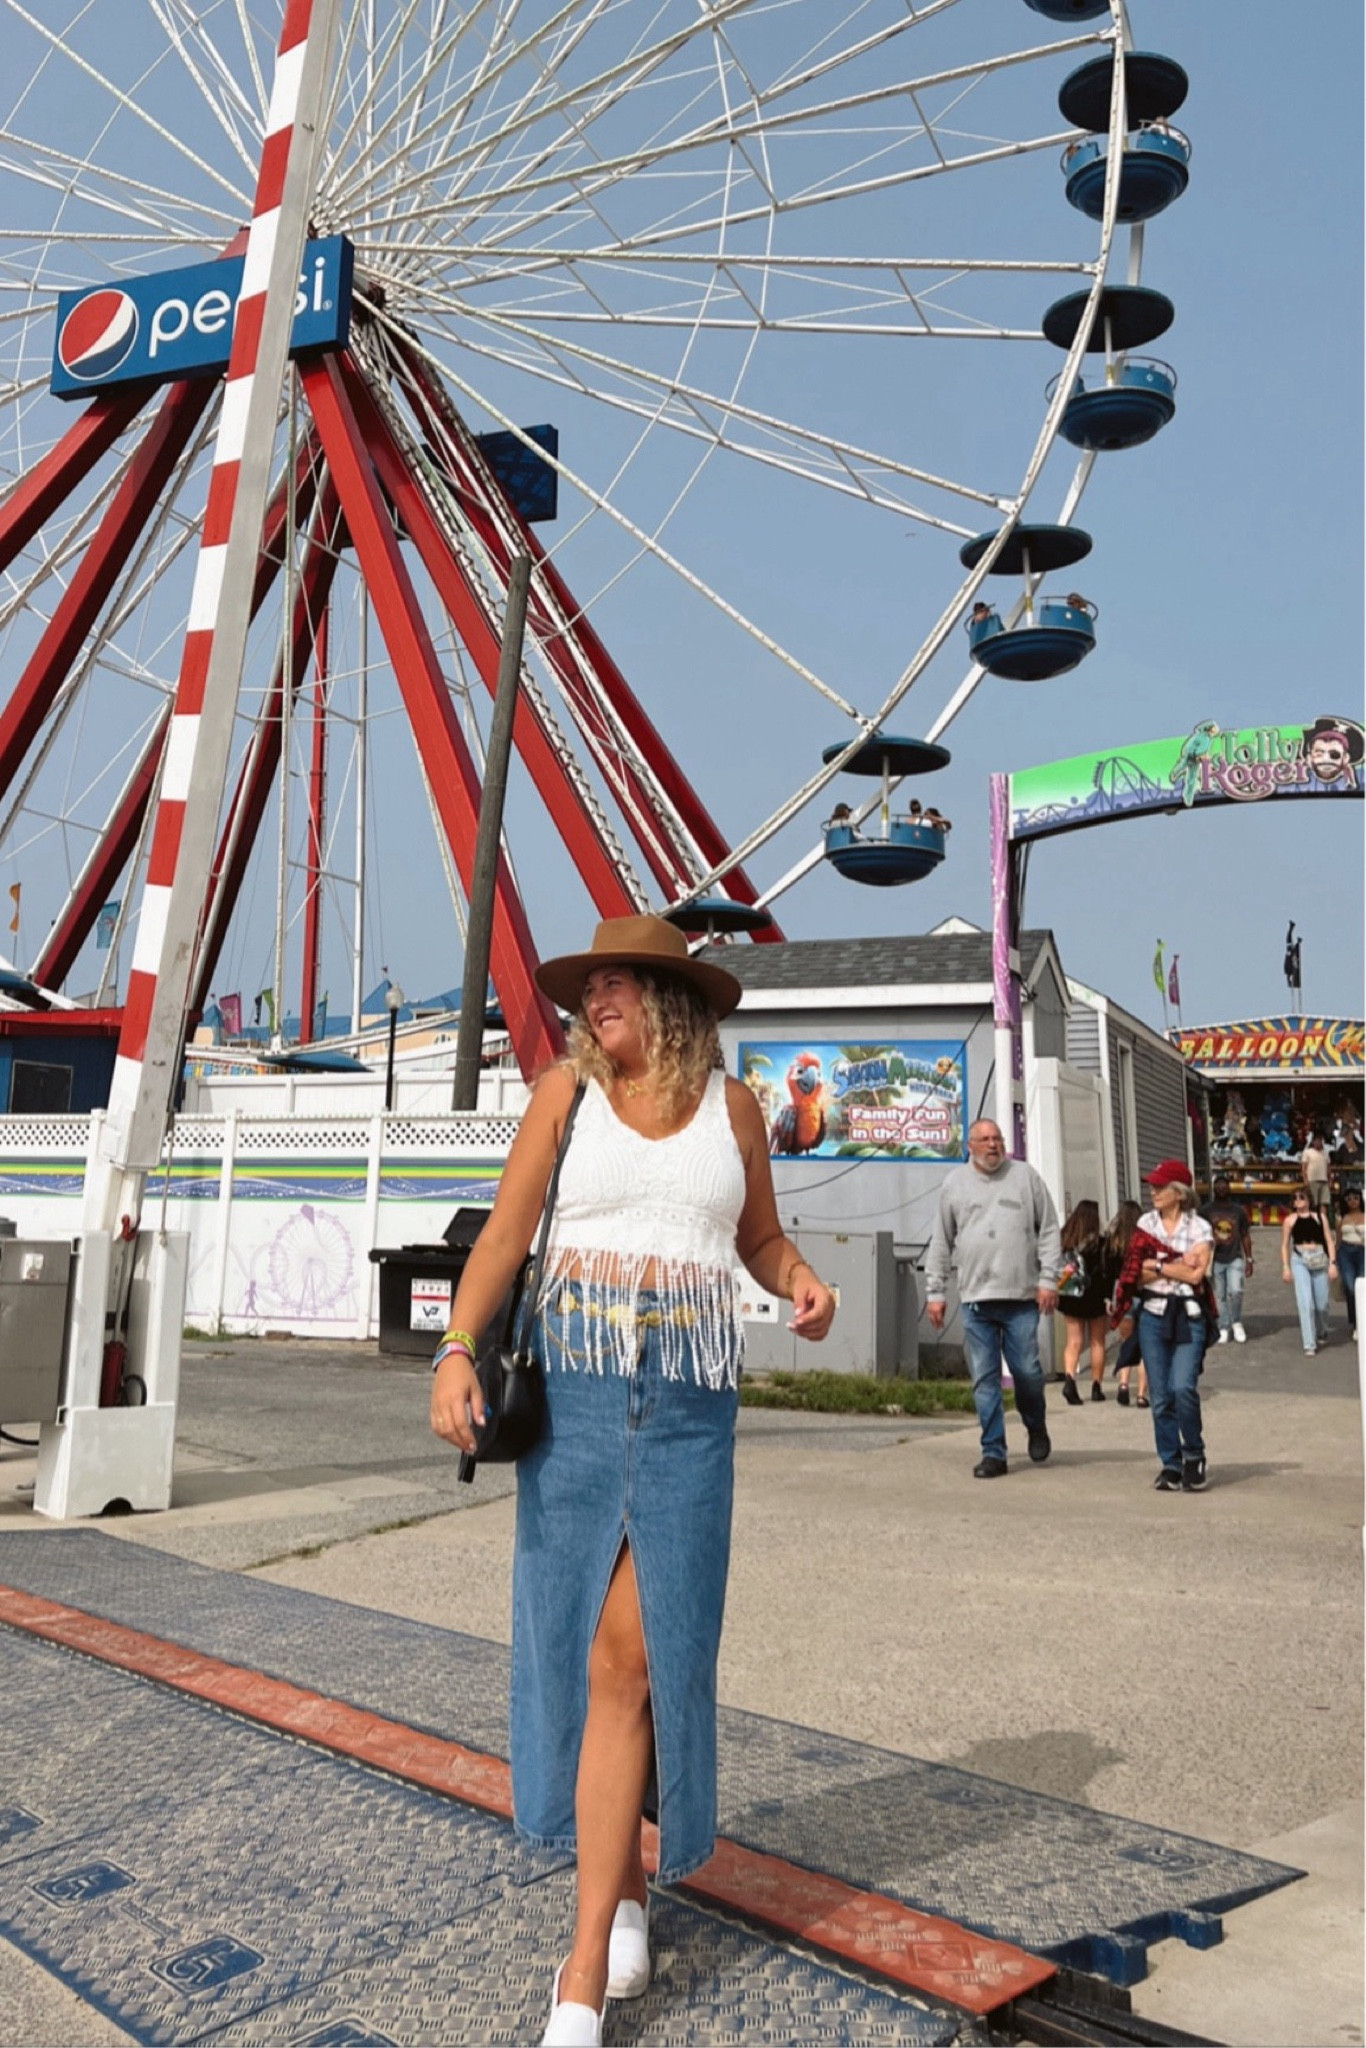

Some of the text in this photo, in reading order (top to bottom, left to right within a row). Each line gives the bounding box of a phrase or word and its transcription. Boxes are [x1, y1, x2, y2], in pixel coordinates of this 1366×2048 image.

[148, 256, 325, 359] pesi
[1212, 730, 1304, 770] Jolly
[1200, 759, 1309, 799] Roger
[1180, 1034, 1325, 1060] BALLOON
[851, 1107, 947, 1124] Family Fun
[906, 1128, 948, 1140] Sun!
